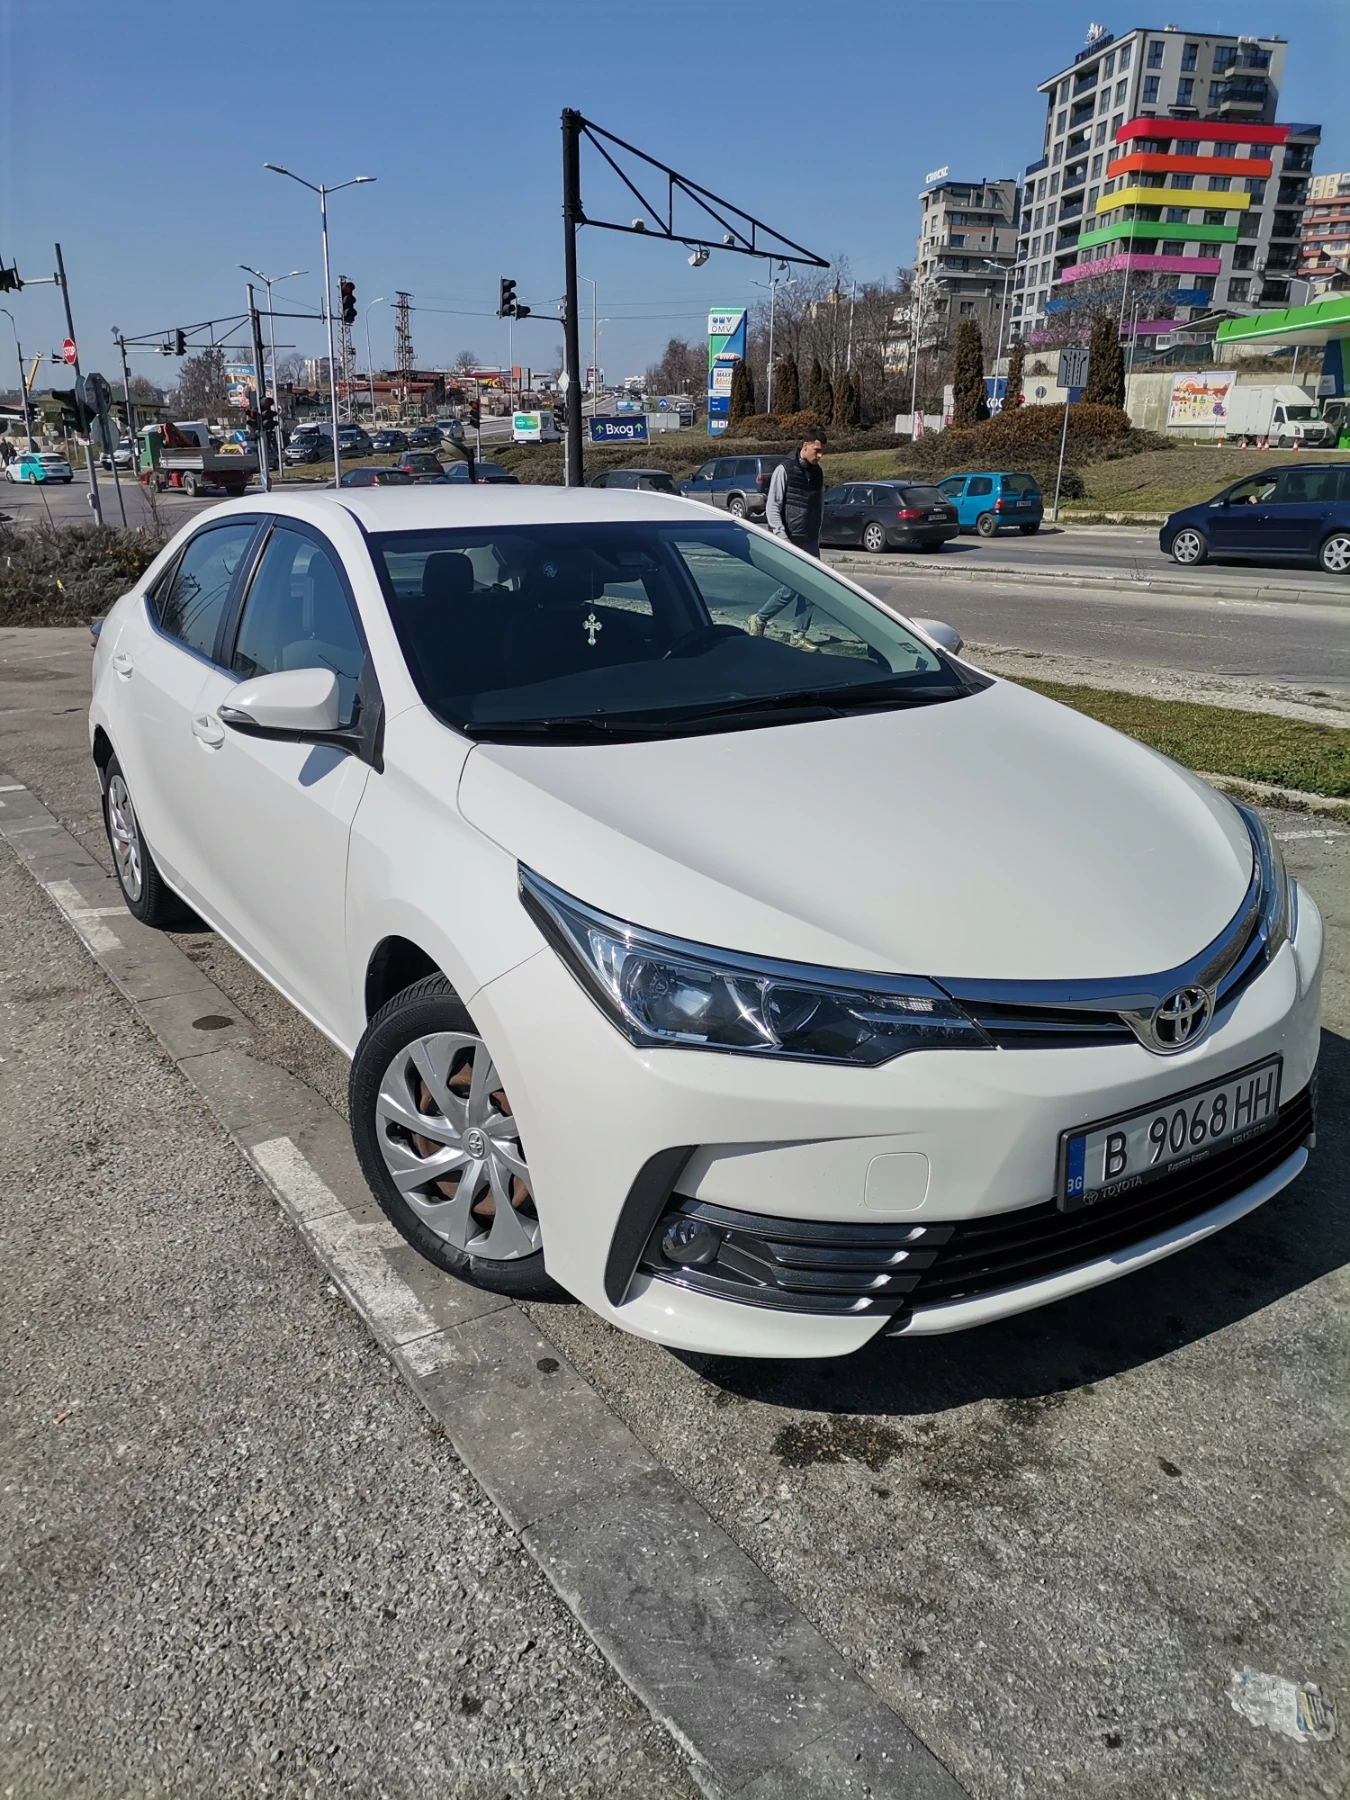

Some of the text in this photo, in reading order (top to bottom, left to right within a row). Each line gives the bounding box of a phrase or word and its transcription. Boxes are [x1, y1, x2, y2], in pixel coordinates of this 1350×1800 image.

[64, 346, 76, 356] STOP
[1102, 1072, 1274, 1182] B 9068 HH
[1067, 1176, 1082, 1192] BG
[1101, 1175, 1143, 1198] TOYOTA
